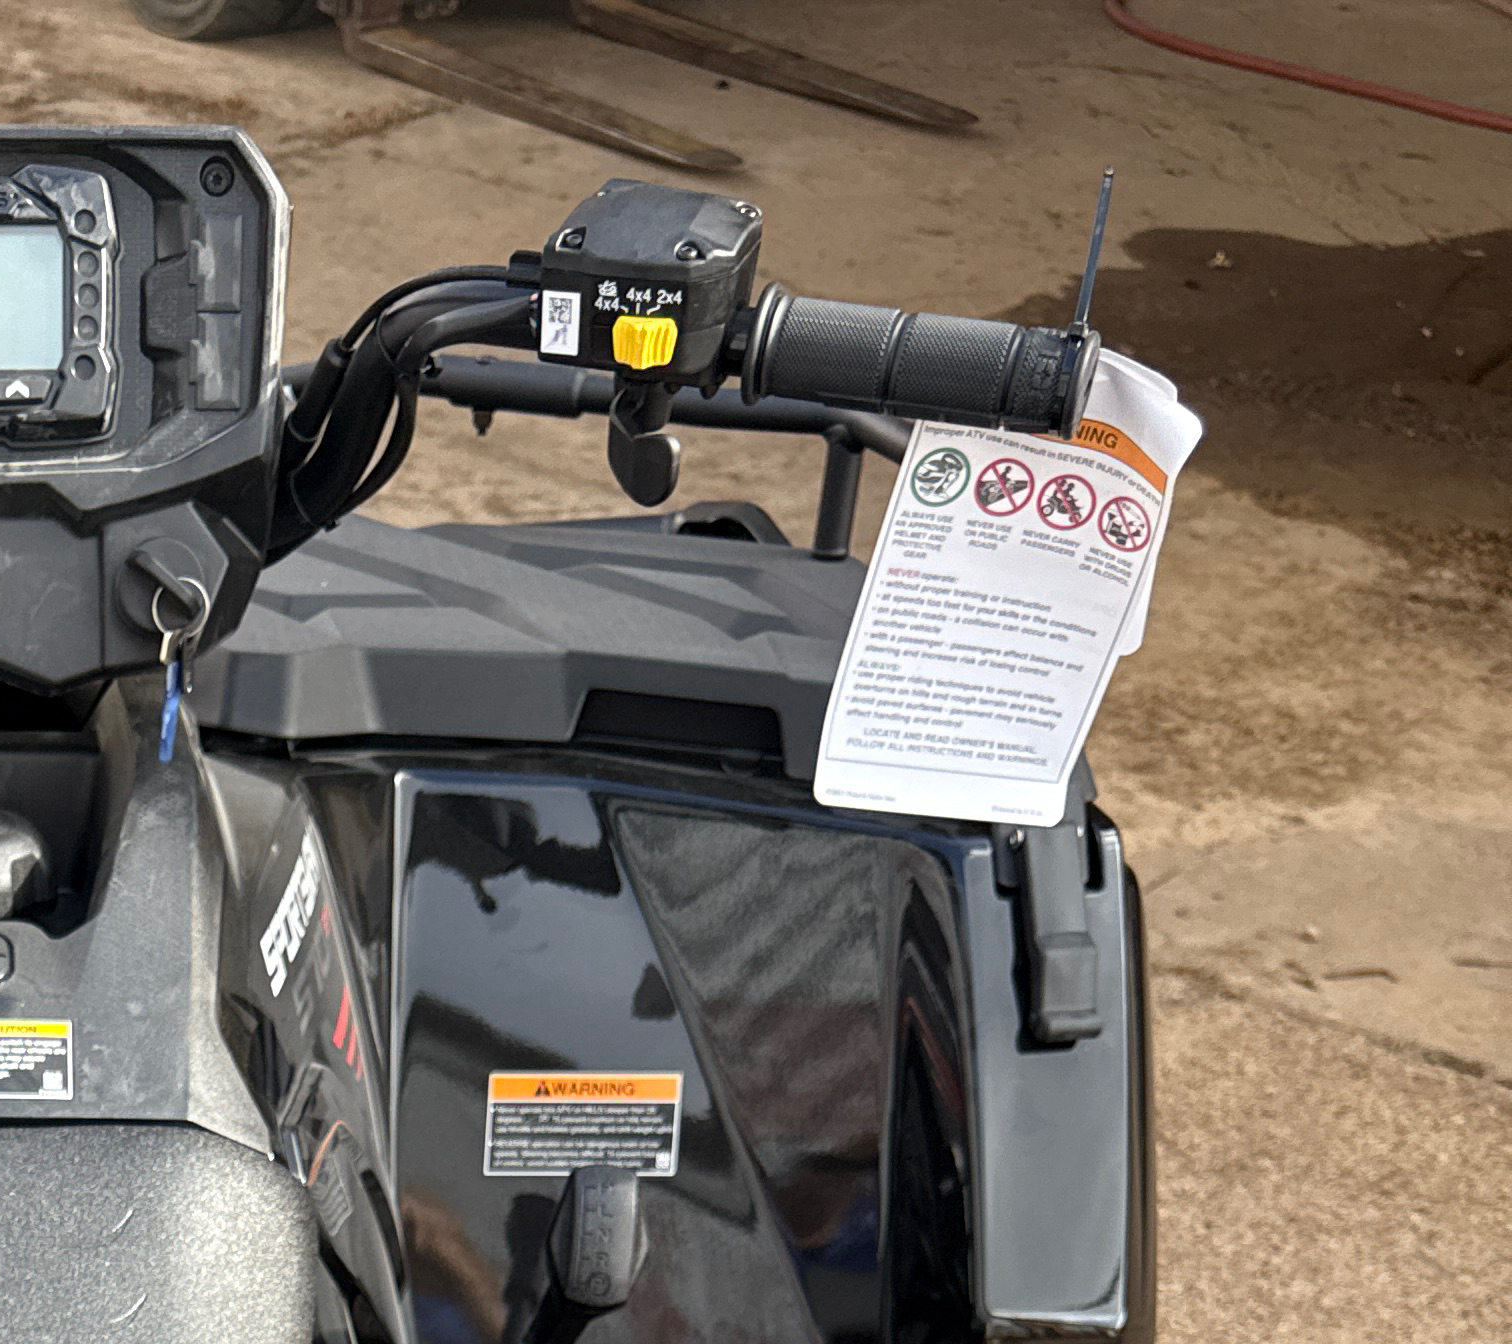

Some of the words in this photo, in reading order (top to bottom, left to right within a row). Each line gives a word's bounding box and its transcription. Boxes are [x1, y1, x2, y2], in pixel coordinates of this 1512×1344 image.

[626, 288, 652, 302] 4x4
[657, 289, 683, 304] 2x4
[594, 298, 620, 311] 4x4
[552, 1081, 637, 1098] WARNING
